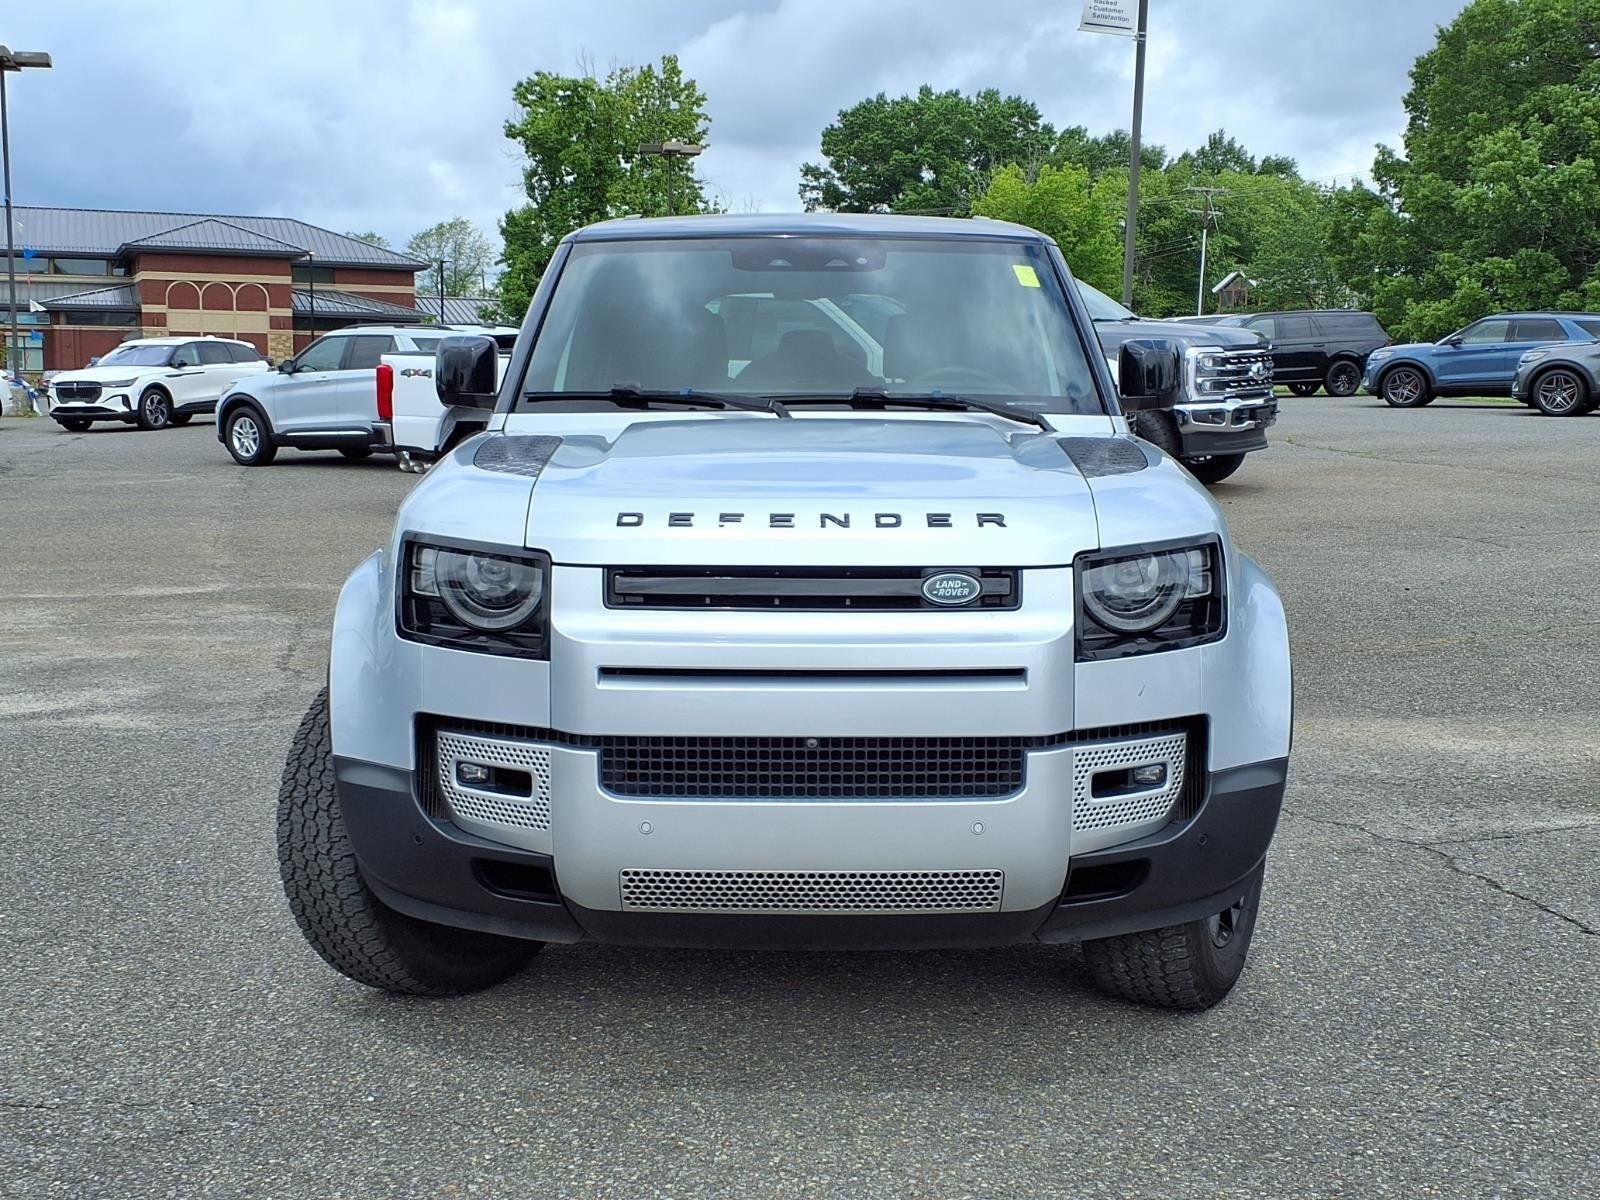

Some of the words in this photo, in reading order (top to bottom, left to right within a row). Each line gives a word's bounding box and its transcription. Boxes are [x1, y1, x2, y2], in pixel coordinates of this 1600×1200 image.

[1093, 5, 1124, 14] Customer
[1092, 12, 1130, 22] Satisfaction
[616, 511, 1008, 528] DEFENDER
